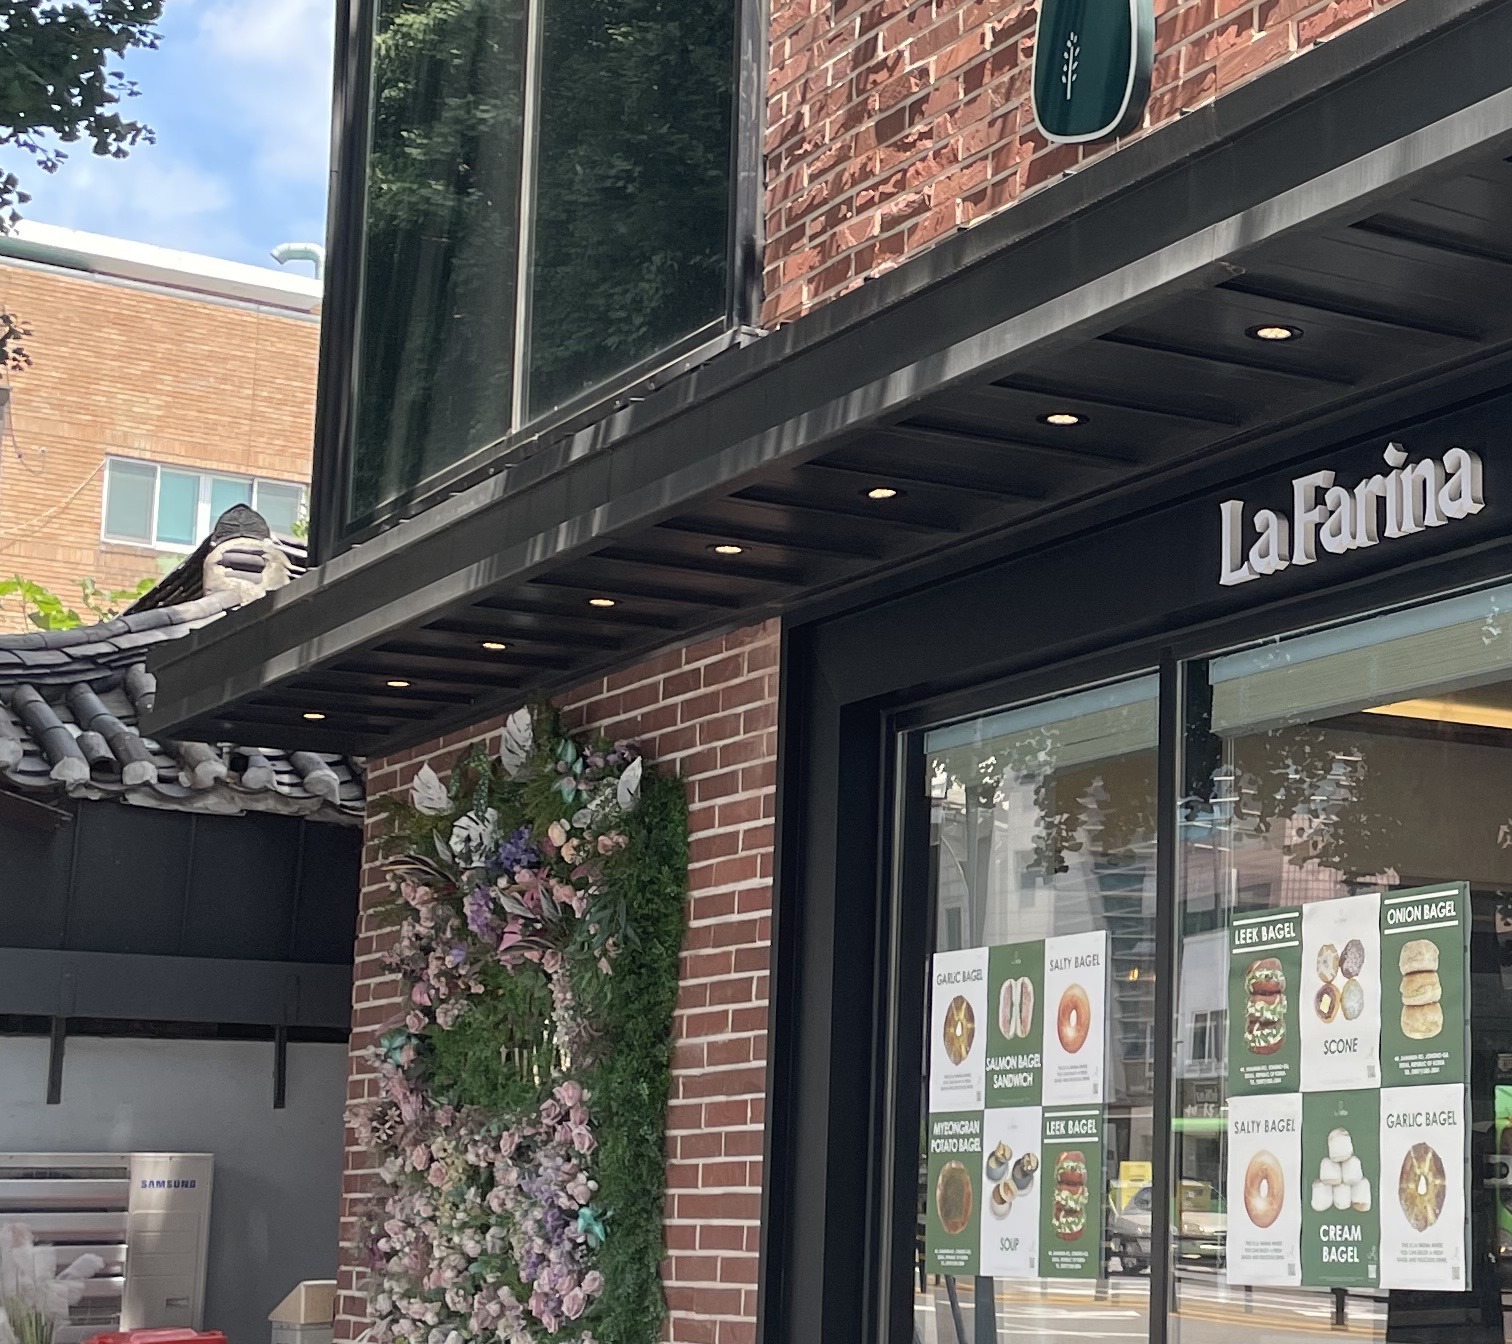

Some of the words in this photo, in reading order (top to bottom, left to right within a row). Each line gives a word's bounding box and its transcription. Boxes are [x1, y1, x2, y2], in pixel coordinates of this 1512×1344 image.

[1387, 906, 1421, 925] ONION
[1423, 901, 1456, 919] BAGEL
[1235, 928, 1259, 945] LEEK
[1261, 922, 1296, 941] BAGEL
[1050, 957, 1072, 971] SALTY
[1075, 954, 1100, 969] BAGEL
[937, 972, 960, 986] GARLIC
[962, 969, 983, 983] BAGEL
[1324, 1038, 1358, 1055] SCONE
[986, 1056, 1016, 1072] SALMON
[1018, 1053, 1041, 1069] BAGEL
[993, 1072, 1033, 1089] SANDWICH
[1046, 1120, 1066, 1136] LEEK
[1068, 1119, 1097, 1135] BAGEL
[1234, 1119, 1261, 1134] SALTY
[1265, 1118, 1295, 1133] BAGEL
[1386, 1113, 1423, 1128] GARLIC
[1426, 1110, 1457, 1126] BAGEL
[933, 1120, 979, 1136] MYEONGRAN
[931, 1138, 957, 1153] POTATO
[959, 1137, 981, 1152] BAGEL
[141, 1180, 196, 1188] SAMSUNG
[1320, 1225, 1362, 1241] CREAM
[1000, 1237, 1020, 1252] SOUP
[1323, 1246, 1359, 1262] BAGEL
